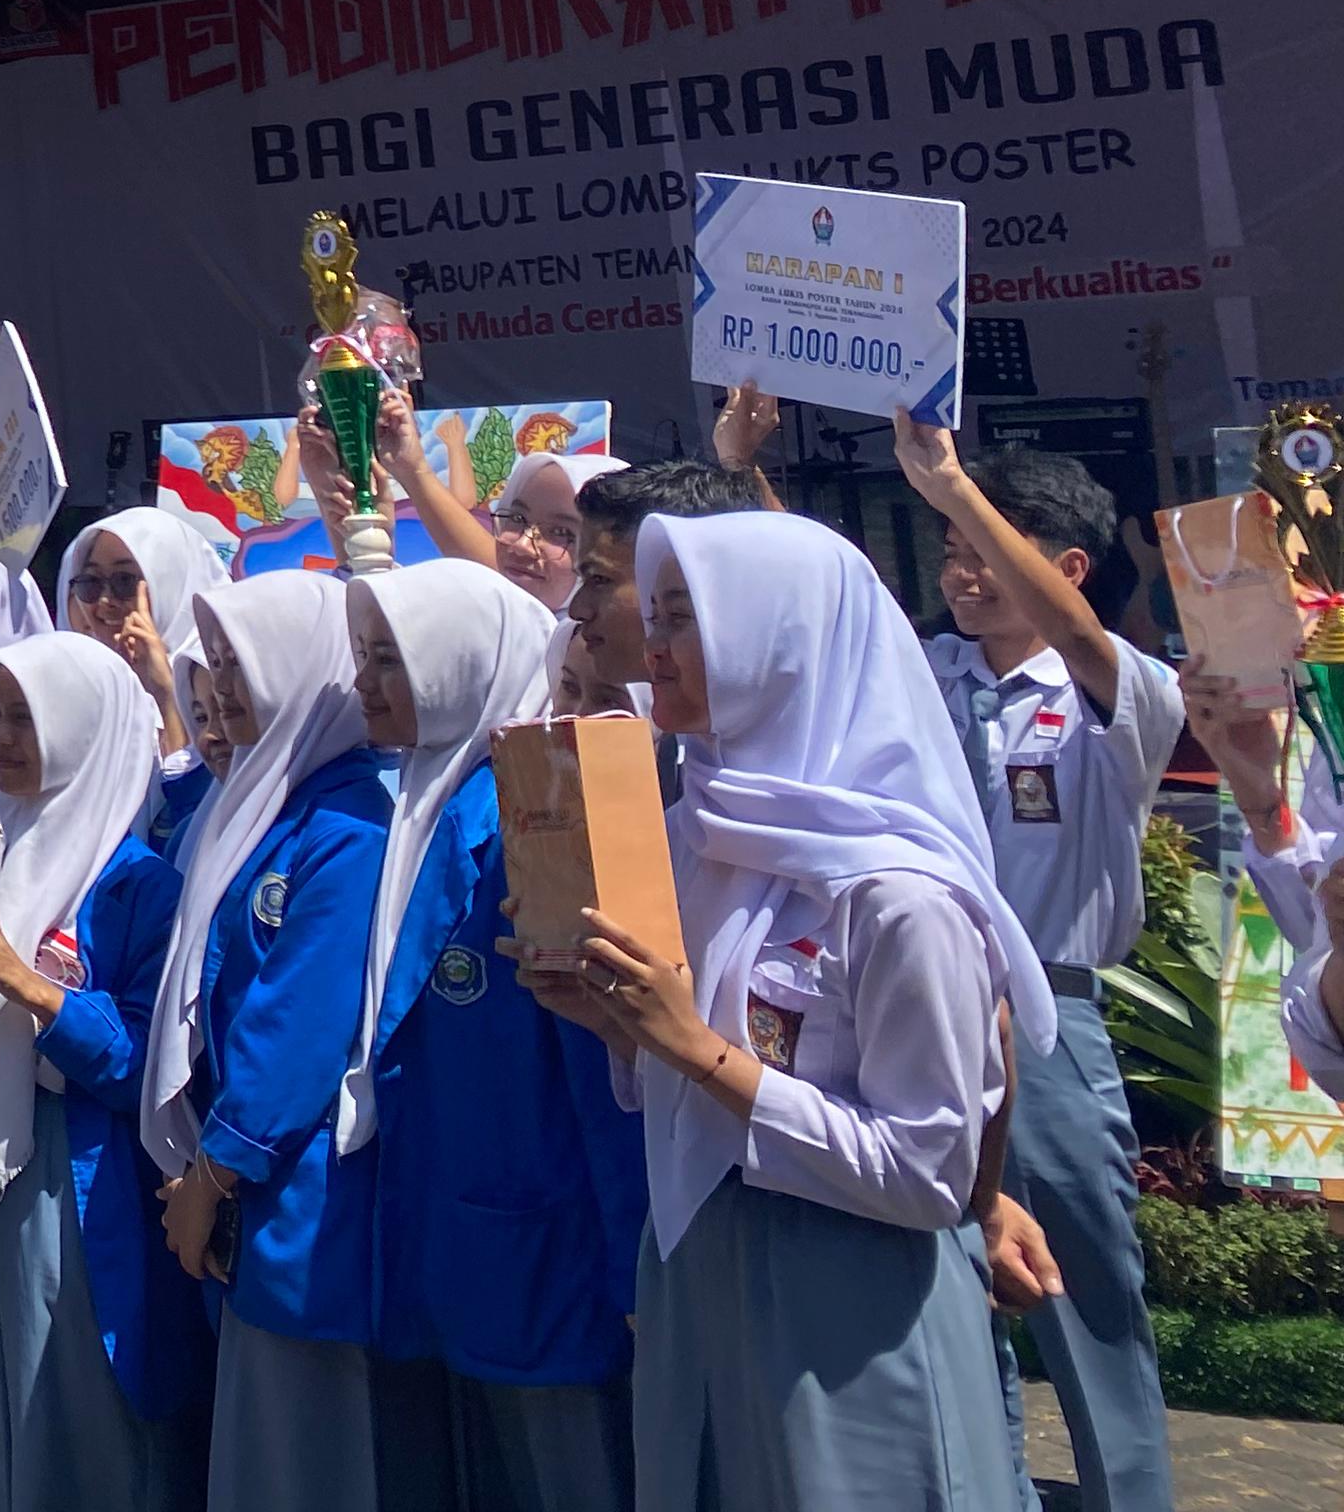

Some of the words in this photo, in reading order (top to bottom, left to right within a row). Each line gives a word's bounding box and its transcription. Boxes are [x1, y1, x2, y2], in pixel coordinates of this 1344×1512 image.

[251, 108, 435, 185] BAGI
[467, 55, 889, 161] GENERASI
[925, 17, 1224, 114] MUDA
[338, 188, 536, 240] MELALUI
[557, 171, 696, 221] LOMB
[921, 128, 1136, 186] POSTER
[982, 212, 1069, 248] 2024
[406, 253, 580, 296] ABUPATEN
[592, 245, 696, 280] TEMAN
[746, 251, 883, 291] HARAPAN
[894, 273, 904, 294] I
[967, 259, 1201, 304] Berkualitas
[458, 305, 554, 341] Muda
[561, 296, 683, 333] Cerdas
[723, 314, 757, 352] RP.
[767, 322, 925, 382] 1.000.000,-
